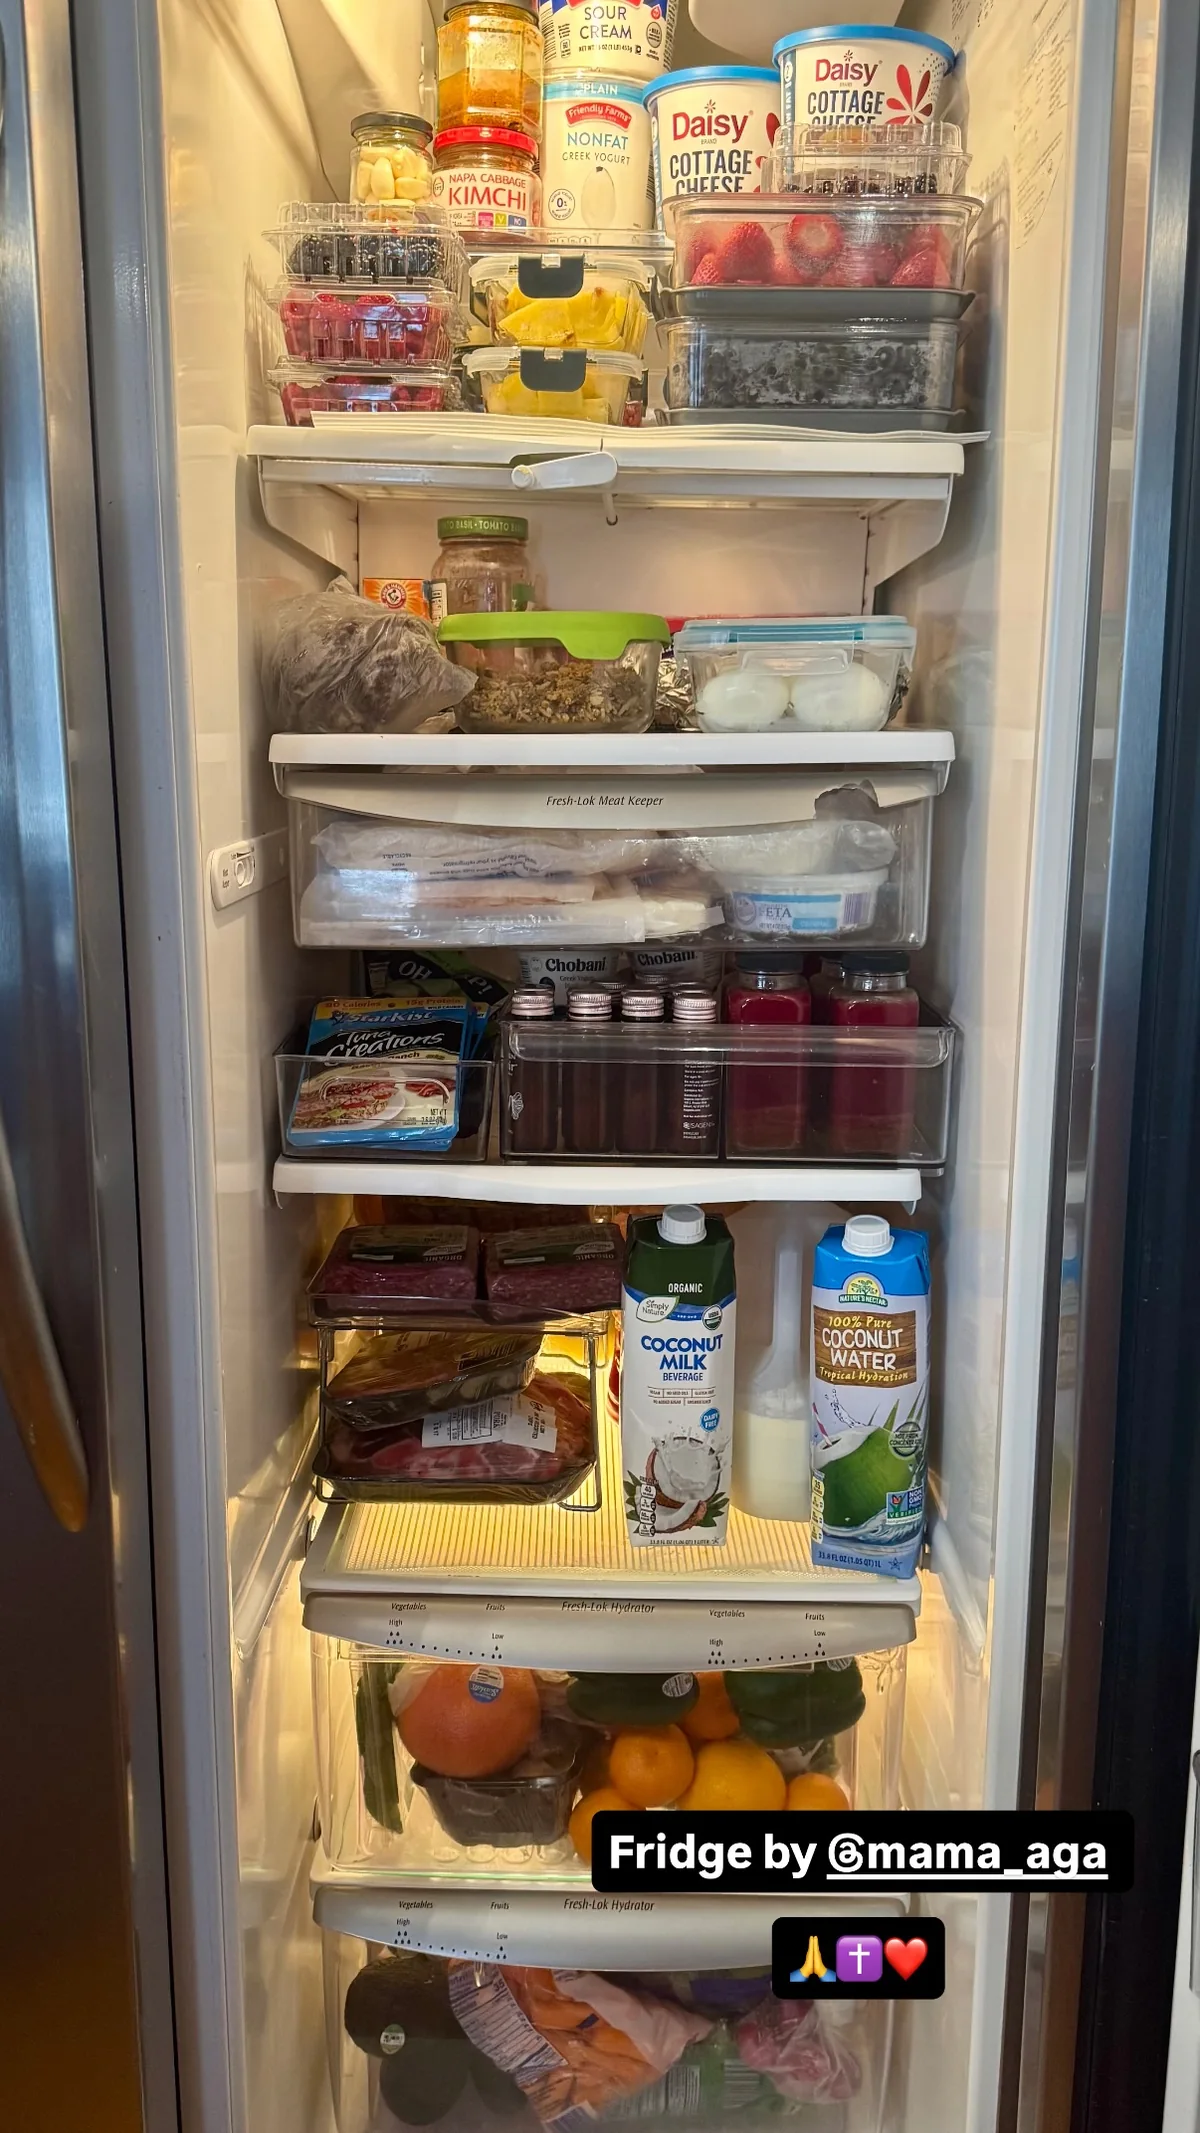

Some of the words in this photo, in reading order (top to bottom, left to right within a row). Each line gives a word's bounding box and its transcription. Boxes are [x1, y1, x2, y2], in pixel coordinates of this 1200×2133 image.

[584, 6, 627, 21] SOUR
[579, 25, 632, 40] CREAM
[815, 59, 878, 87] Daisy
[583, 83, 618, 95] PLAIN
[808, 90, 886, 115] COTTAGE
[568, 104, 604, 119] Friendly
[604, 106, 629, 122] Farms
[672, 112, 748, 144] Daisy
[567, 132, 628, 150] NONFAT
[562, 152, 591, 162] GREEK
[594, 152, 630, 166] YOGURT
[670, 149, 753, 180] COTTAGE
[449, 173, 477, 184] NAPA
[480, 174, 526, 188] CABBAGE
[448, 186, 526, 211] KIMCHI
[478, 520, 509, 531] TOMATO
[546, 796, 596, 806] Fresh-Lok
[598, 796, 625, 806] Meat
[628, 796, 664, 808] Keeper
[545, 956, 607, 972] Chobani
[638, 950, 697, 967] Chobani
[399, 961, 432, 980] OH
[342, 1000, 381, 1008] Calories
[347, 1010, 434, 1023] StarKist
[337, 1031, 392, 1047] Tuna
[324, 1032, 446, 1067] Creations
[575, 1253, 614, 1261] ORGANIC
[668, 1283, 704, 1294] ORGANIC
[646, 1299, 670, 1312] Simply
[839, 1294, 866, 1304] NATURE'S
[866, 1296, 888, 1306] NECTAR
[642, 1306, 665, 1317] Nature
[828, 1316, 862, 1328] 100%
[866, 1316, 893, 1328] Pure
[640, 1334, 724, 1353] COCONUT
[822, 1328, 904, 1350] COCONUT
[659, 1354, 708, 1370] MILK
[830, 1350, 896, 1370] WATER
[662, 1372, 704, 1382] BEVERAGE
[820, 1366, 856, 1381] Tropical
[858, 1371, 908, 1382] Hydration
[704, 1420, 717, 1429] FREE
[818, 1550, 830, 1558] 33.8
[832, 1554, 838, 1562] FL
[390, 1602, 427, 1611] Vegetables
[486, 1602, 506, 1611] Fruits
[561, 1601, 608, 1612] Fresh-Lok
[610, 1602, 656, 1615] Hydrator
[708, 1608, 746, 1619] Vegetables
[804, 1612, 825, 1622] Fruits
[388, 1618, 403, 1628] High
[492, 1632, 504, 1640] Low
[814, 1629, 826, 1637] Low
[709, 1638, 724, 1648] High
[398, 1900, 434, 1910] Vegetables
[490, 1900, 510, 1910] Fruits
[563, 1898, 609, 1910] Fresh-Lok
[612, 1899, 656, 1912] Hydrator
[396, 1918, 410, 1927] High
[496, 1932, 508, 1940] Low
